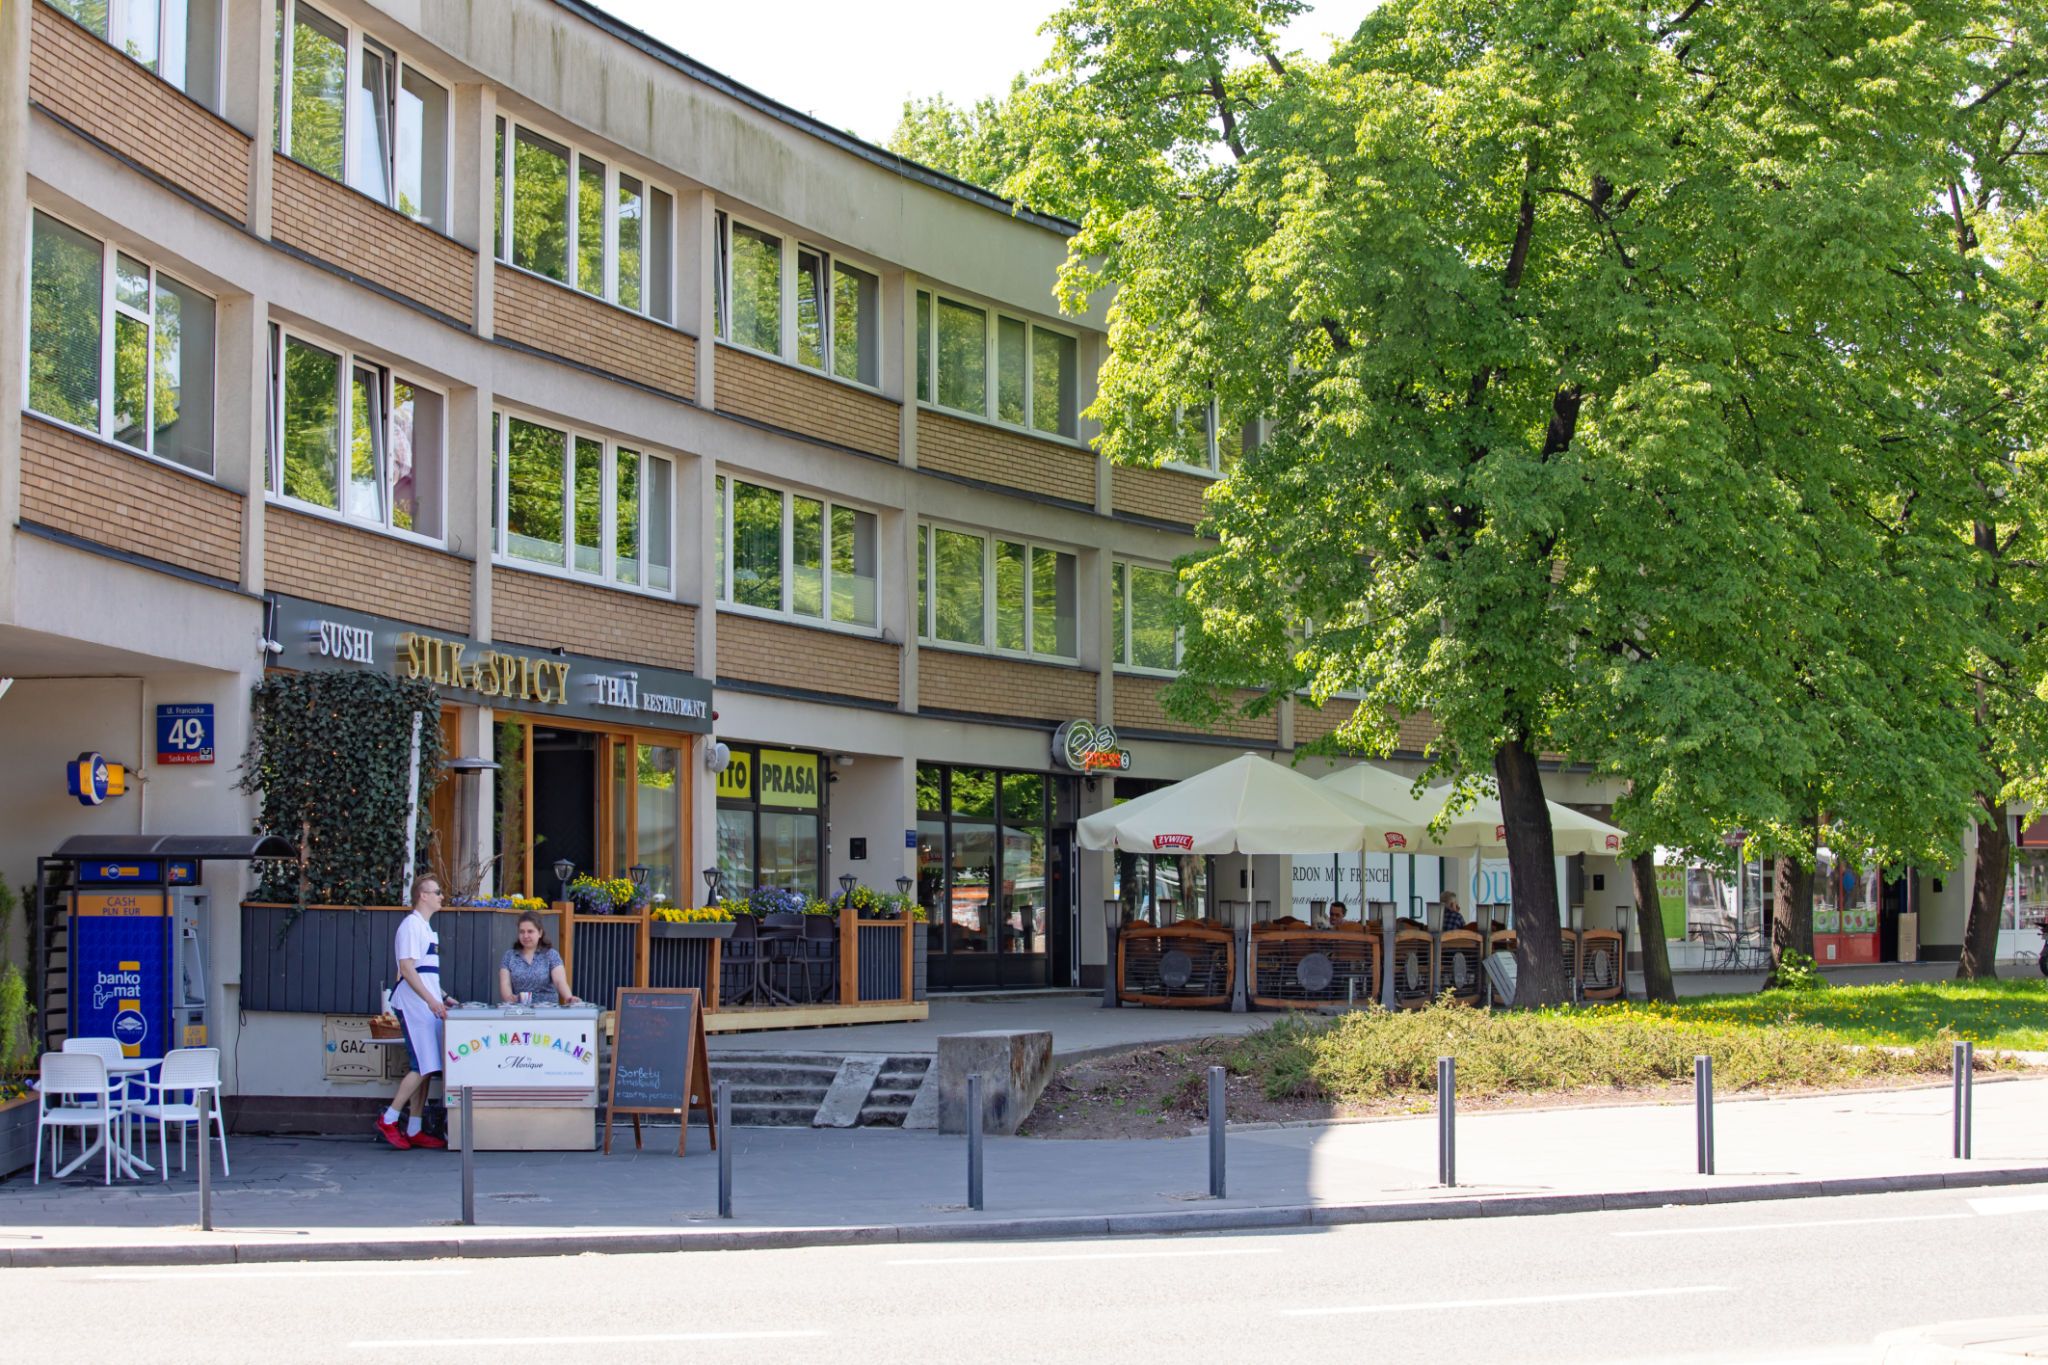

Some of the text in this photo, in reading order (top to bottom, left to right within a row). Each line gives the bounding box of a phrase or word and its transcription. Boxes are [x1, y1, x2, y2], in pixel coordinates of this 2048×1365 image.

[320, 620, 374, 664] SUSHI
[407, 632, 571, 705] SILK & SPICY
[642, 693, 707, 719] RESTAURANT
[168, 717, 203, 750] 49
[761, 763, 817, 795] PRASA
[107, 896, 136, 906] CASH
[102, 907, 141, 916] PLN EUR
[98, 971, 140, 985] banko
[114, 984, 141, 998] mat
[341, 1039, 366, 1054] GAZ
[447, 1031, 593, 1065] LODY NATURALNE
[497, 1055, 543, 1070] Monique
